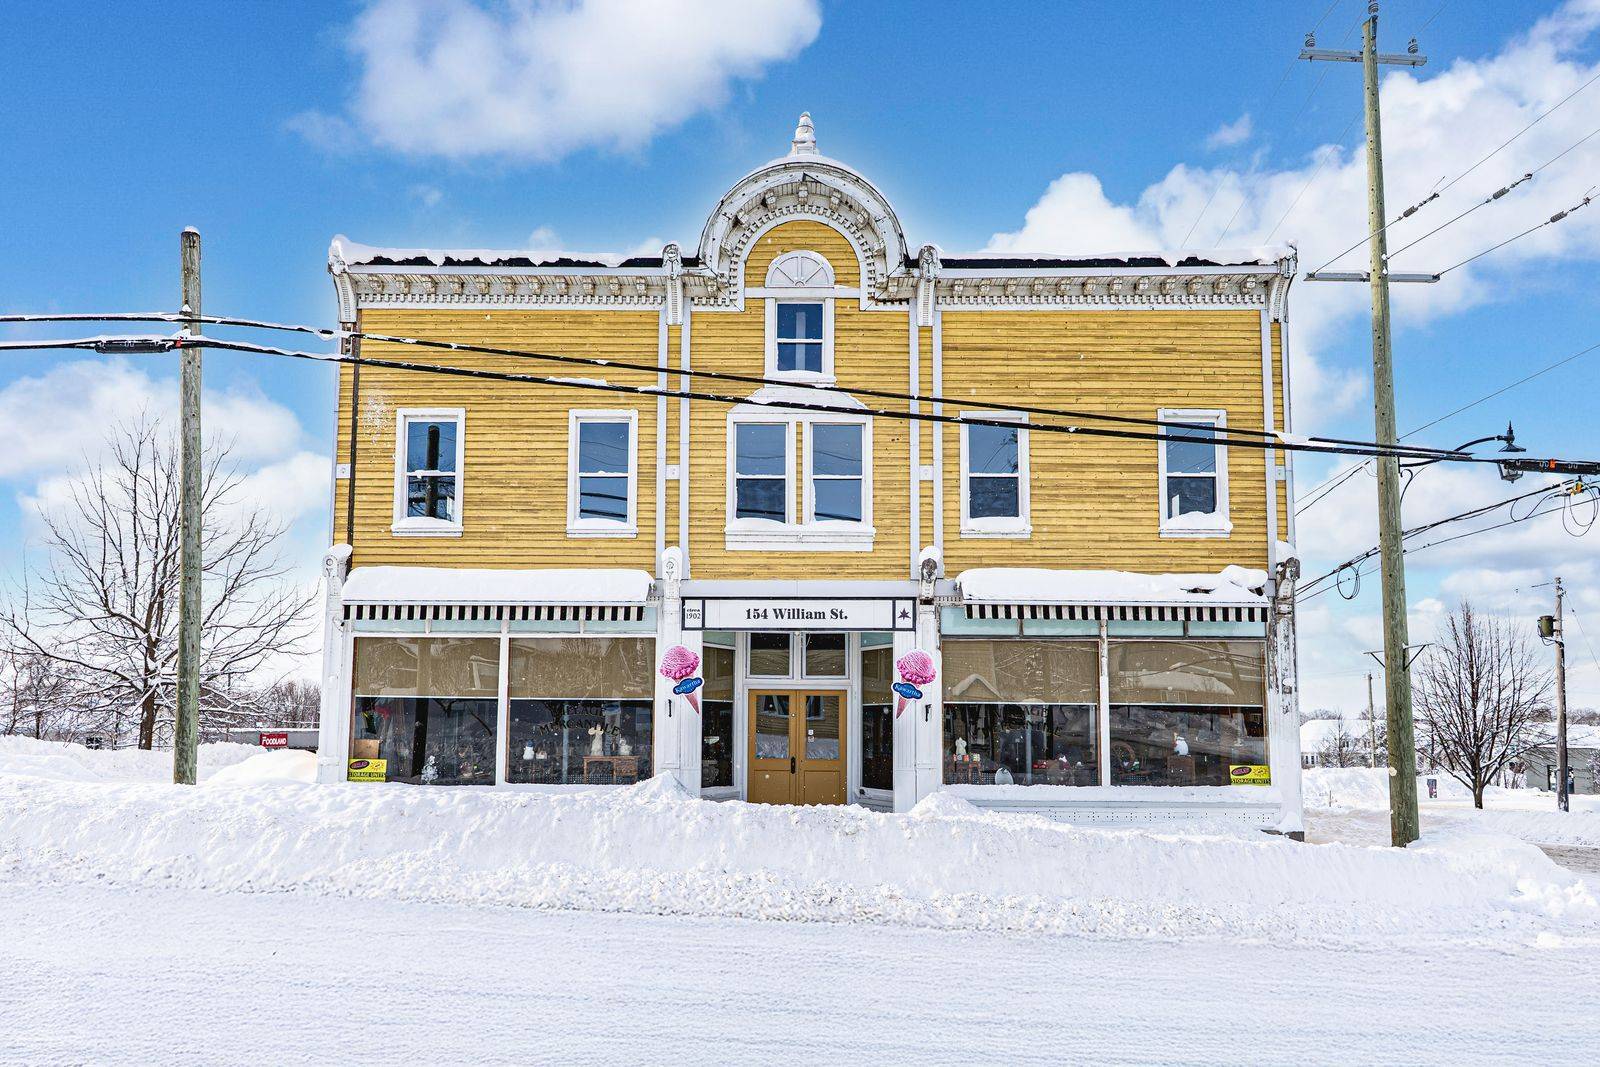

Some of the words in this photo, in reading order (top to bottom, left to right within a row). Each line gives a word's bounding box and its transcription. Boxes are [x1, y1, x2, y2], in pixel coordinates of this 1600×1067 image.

[745, 607, 769, 620] 154
[772, 607, 826, 620] William
[830, 607, 848, 620] St.
